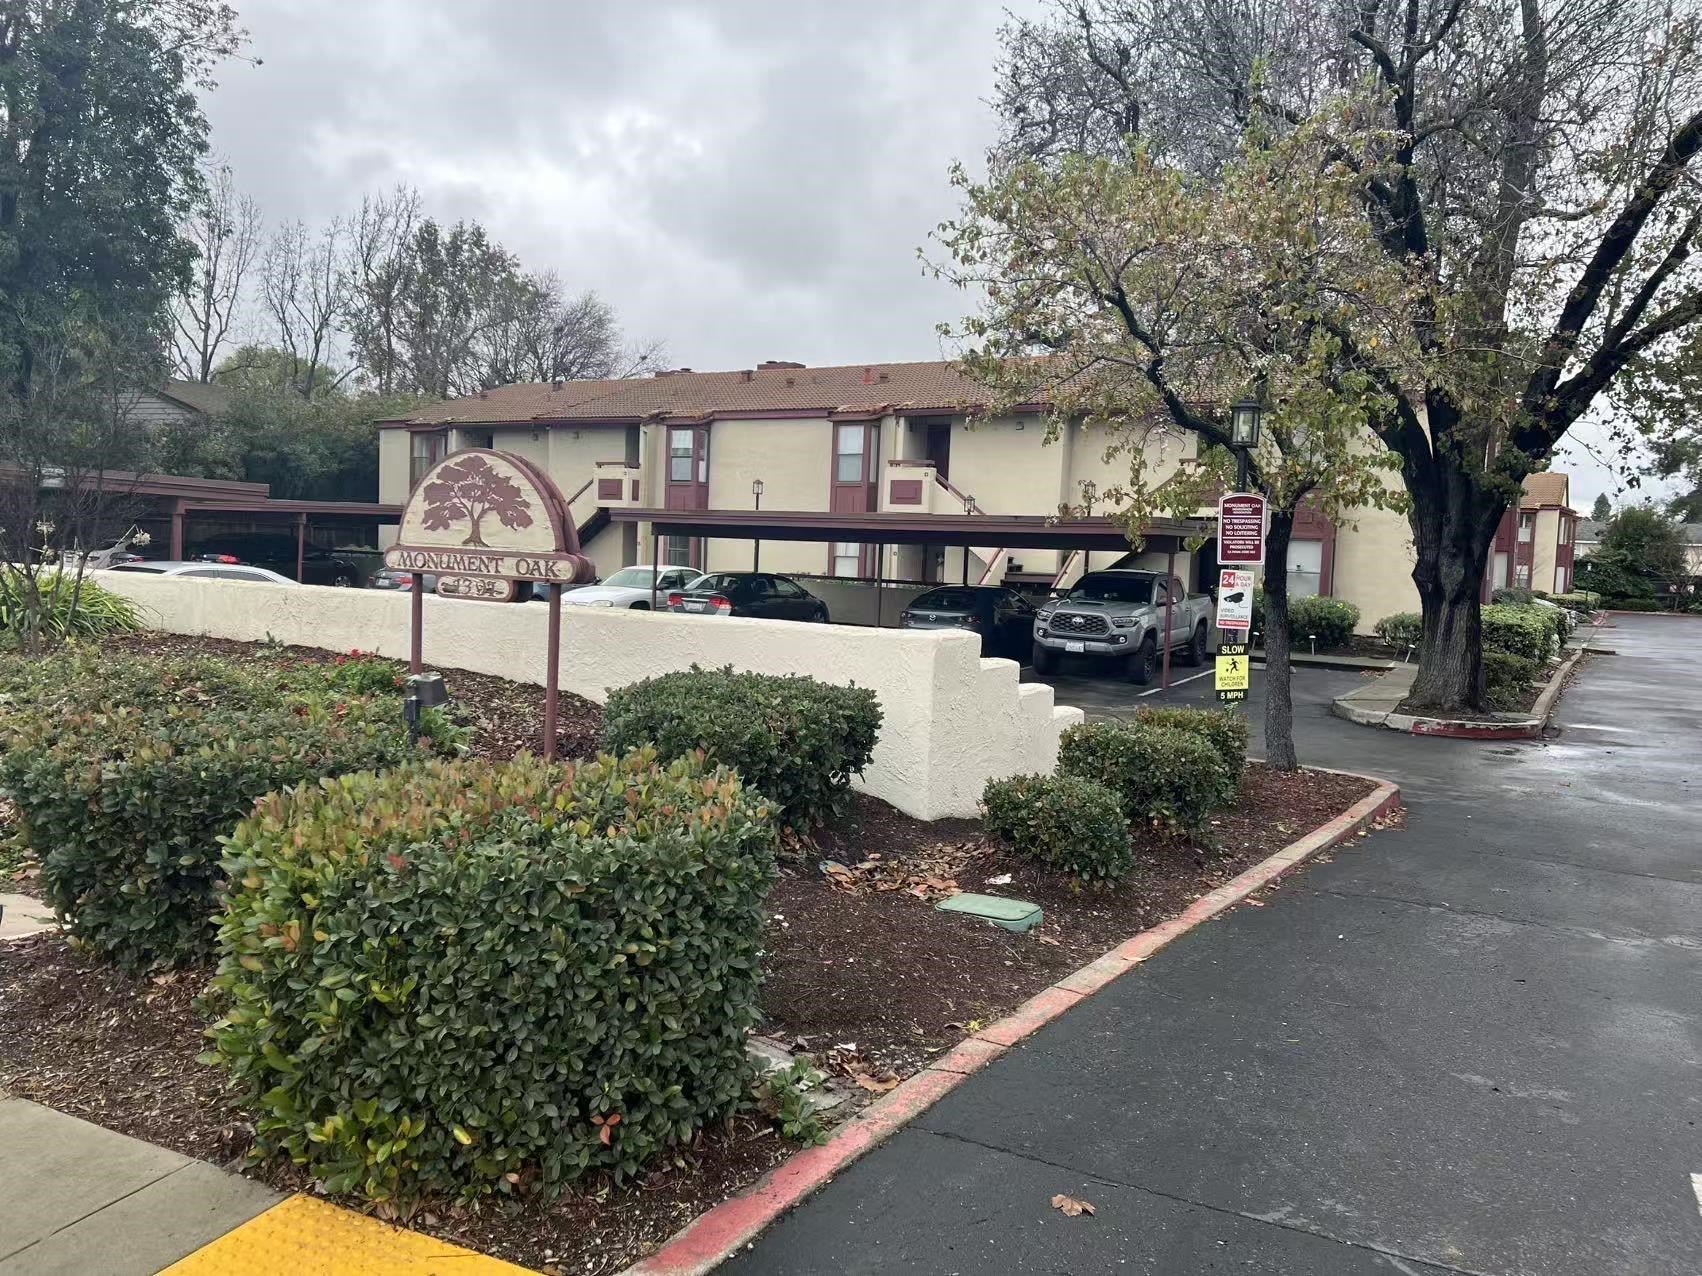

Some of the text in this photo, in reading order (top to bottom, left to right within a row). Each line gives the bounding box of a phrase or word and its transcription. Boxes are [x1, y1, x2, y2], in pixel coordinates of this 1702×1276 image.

[397, 551, 561, 578] MONUMENT OAK
[1223, 575, 1234, 584] 24
[1222, 646, 1244, 654] SLOW
